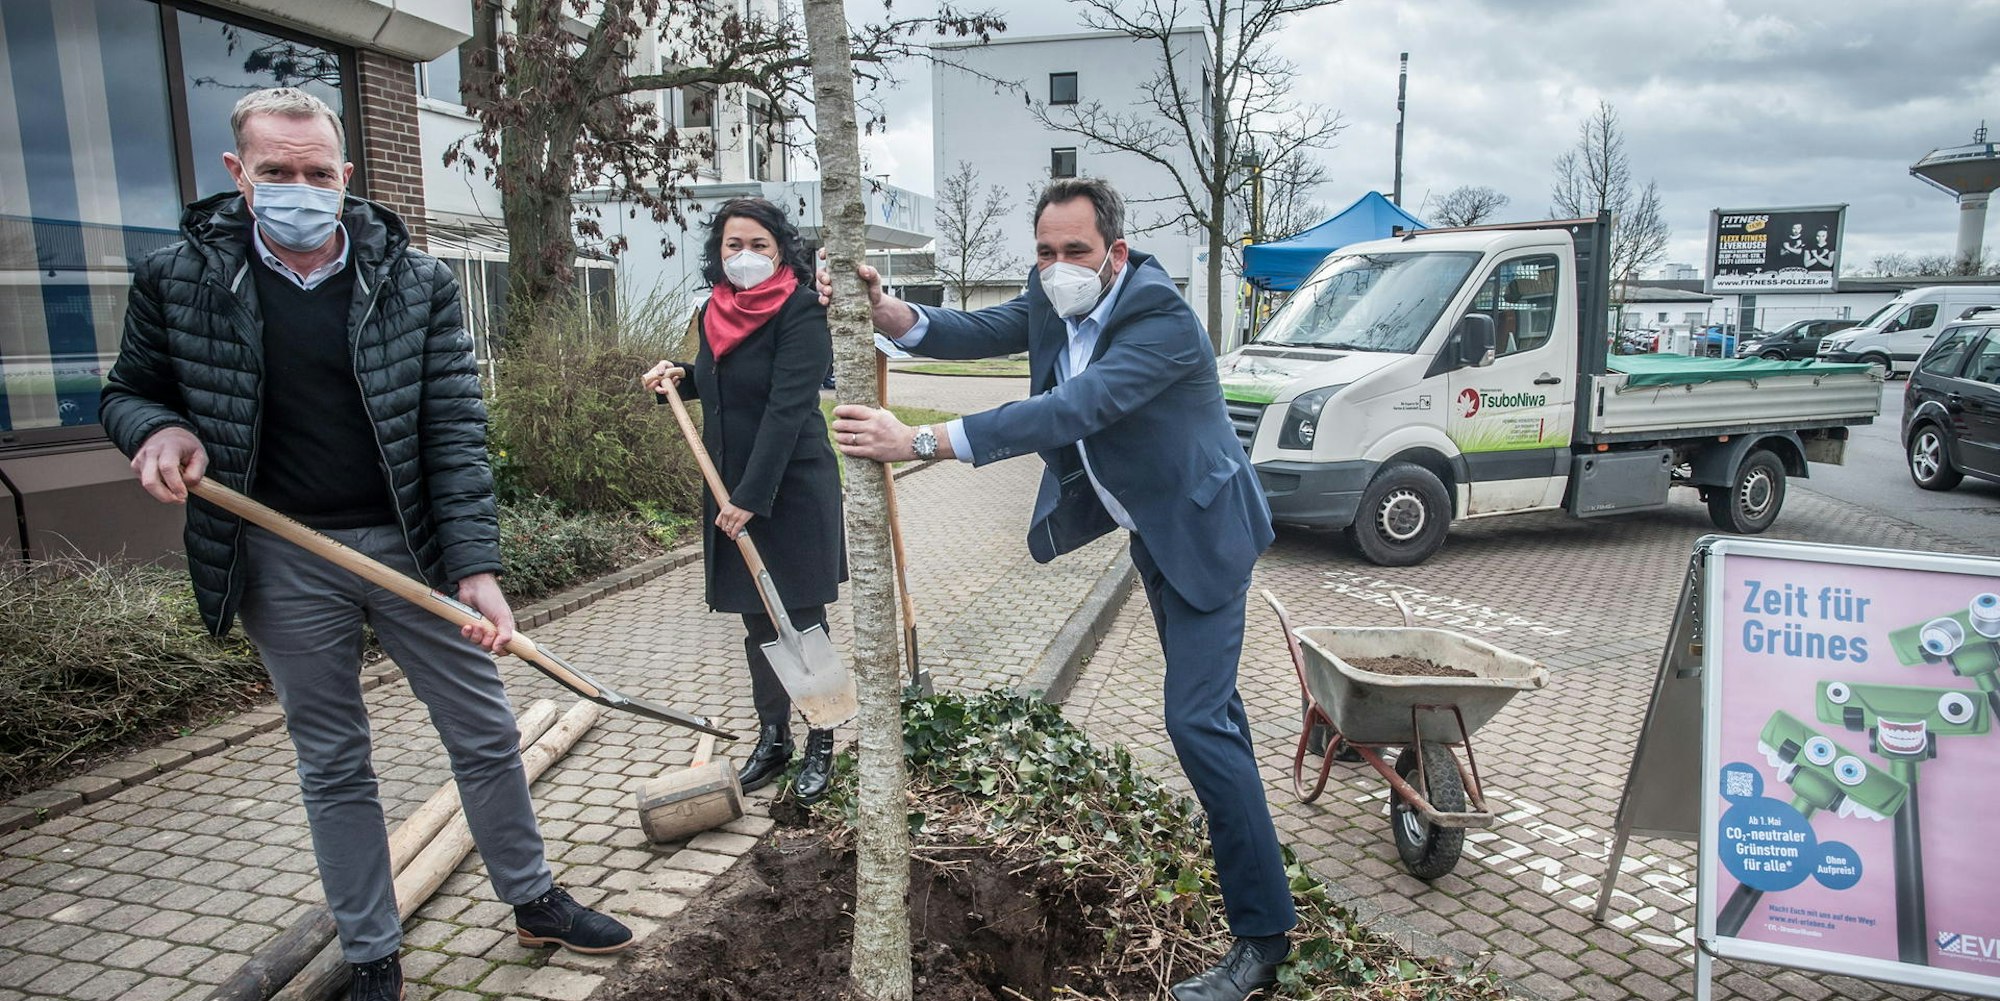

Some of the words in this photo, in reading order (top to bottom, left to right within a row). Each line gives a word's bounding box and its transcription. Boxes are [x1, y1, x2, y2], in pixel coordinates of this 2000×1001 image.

[1722, 215, 1769, 224] FITNESS
[1480, 392, 1546, 408] TsuboNiwa
[1743, 579, 1808, 618] Zeit
[1818, 586, 1871, 623] für
[1742, 619, 1868, 663] Grünes
[1748, 815, 1759, 825] Ab
[1767, 816, 1782, 826] Mai
[1736, 843, 1799, 857] Grünstrom
[1743, 858, 1761, 871] für
[1825, 855, 1847, 865] Ohne
[1817, 865, 1856, 876] Aufpreis!
[1769, 904, 1789, 913] Macht
[1790, 906, 1806, 916] Euch
[1807, 909, 1818, 917] mit
[1819, 911, 1831, 920] uns
[1833, 913, 1844, 921] auf
[1845, 914, 1857, 923] den
